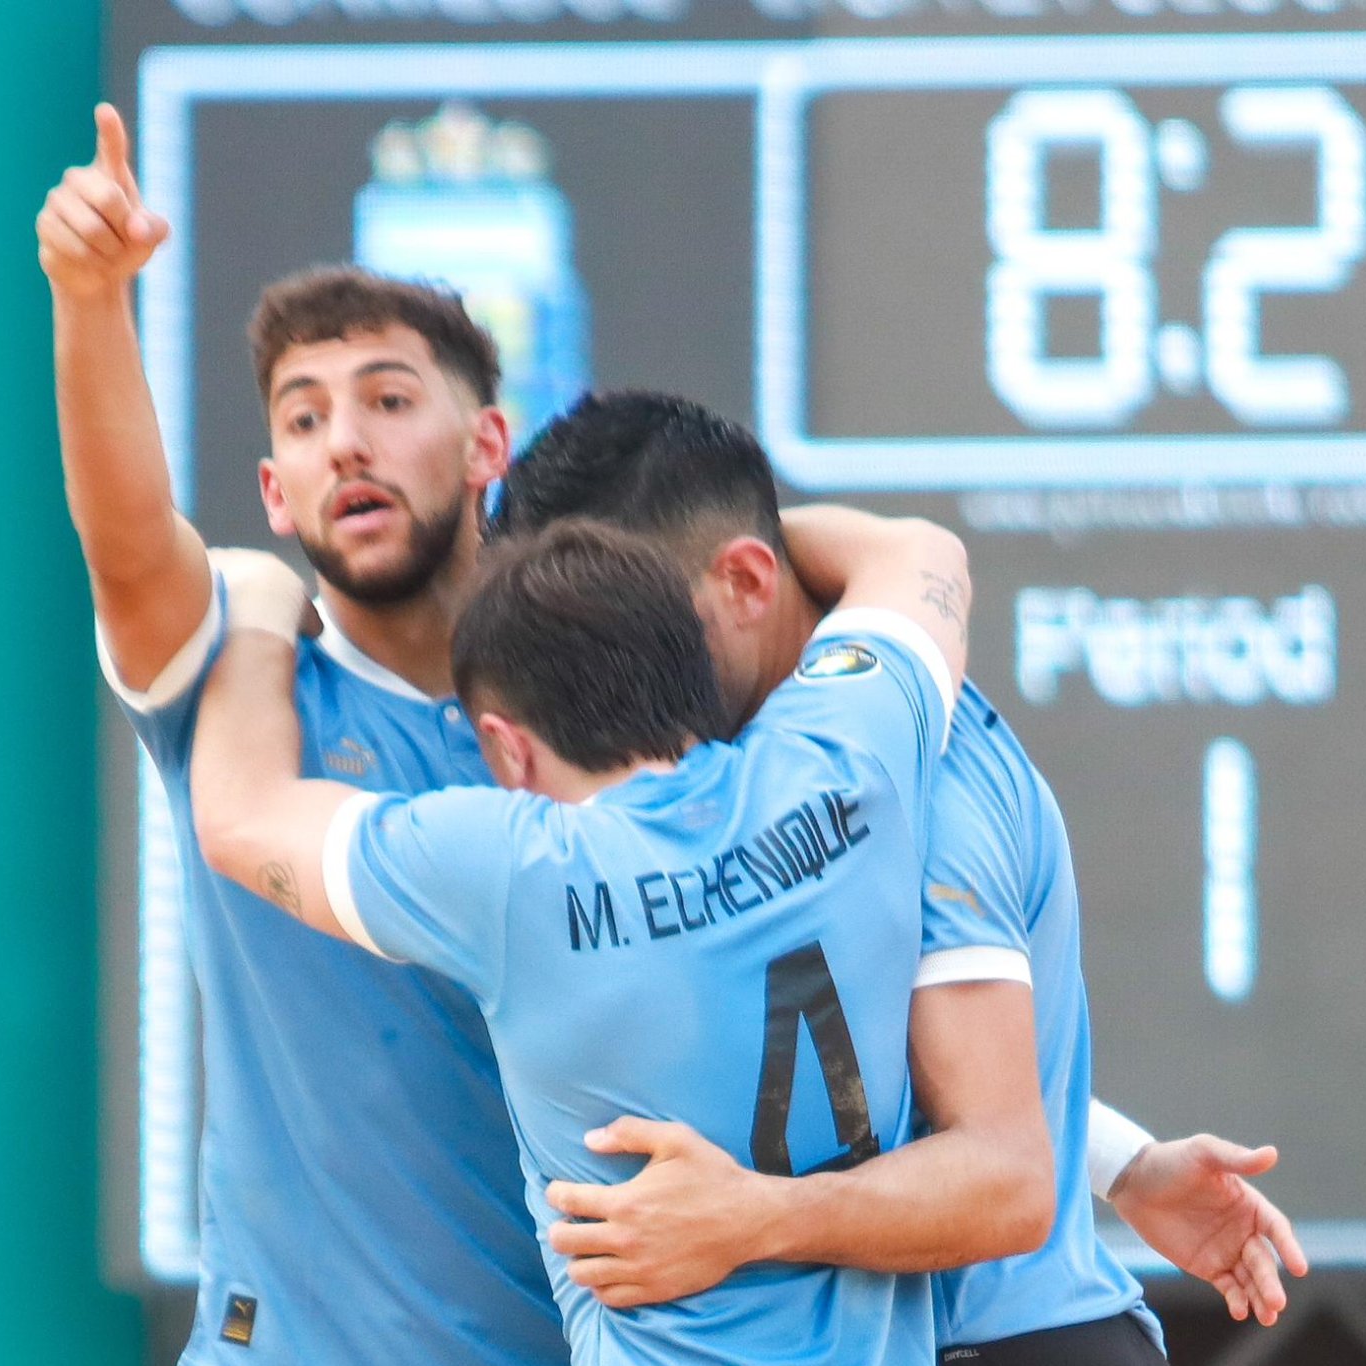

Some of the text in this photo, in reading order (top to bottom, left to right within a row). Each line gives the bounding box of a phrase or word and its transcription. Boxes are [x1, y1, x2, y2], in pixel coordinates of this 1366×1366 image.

[565, 789, 872, 953] M. ECHENIQUE
[1202, 736, 1258, 1002] 1
[749, 940, 880, 1178] 4
